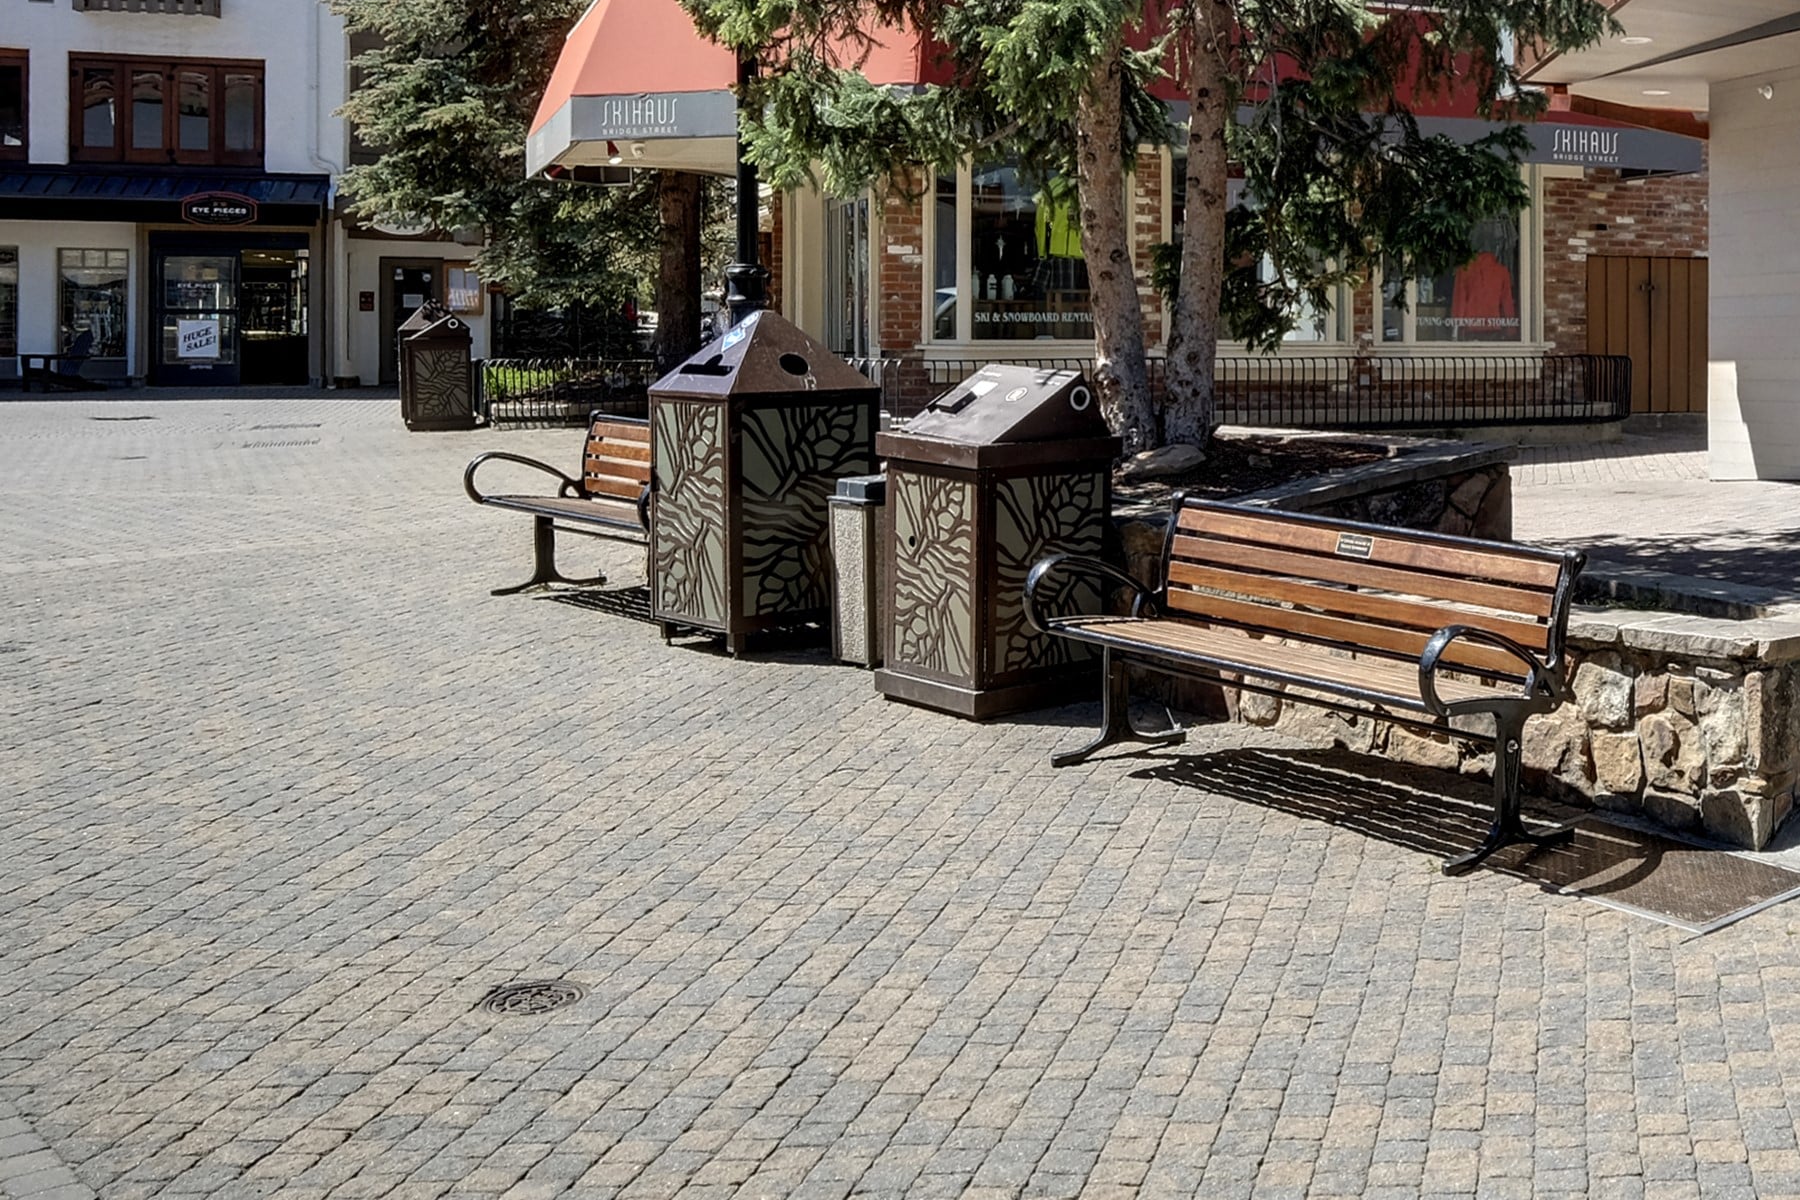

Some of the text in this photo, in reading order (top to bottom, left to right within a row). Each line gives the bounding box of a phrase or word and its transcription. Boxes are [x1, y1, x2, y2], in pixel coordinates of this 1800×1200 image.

[602, 98, 677, 126] SKIHAUS
[642, 126, 678, 134] STREET
[1552, 129, 1619, 154] SKIHAUS
[1553, 153, 1585, 161] BRIDGE
[974, 311, 990, 322] SKI
[1002, 312, 1060, 322] SNOWBOARD
[1487, 318, 1520, 327] STORAGE
[183, 326, 212, 343] HUGE
[186, 335, 216, 352] SALE!
